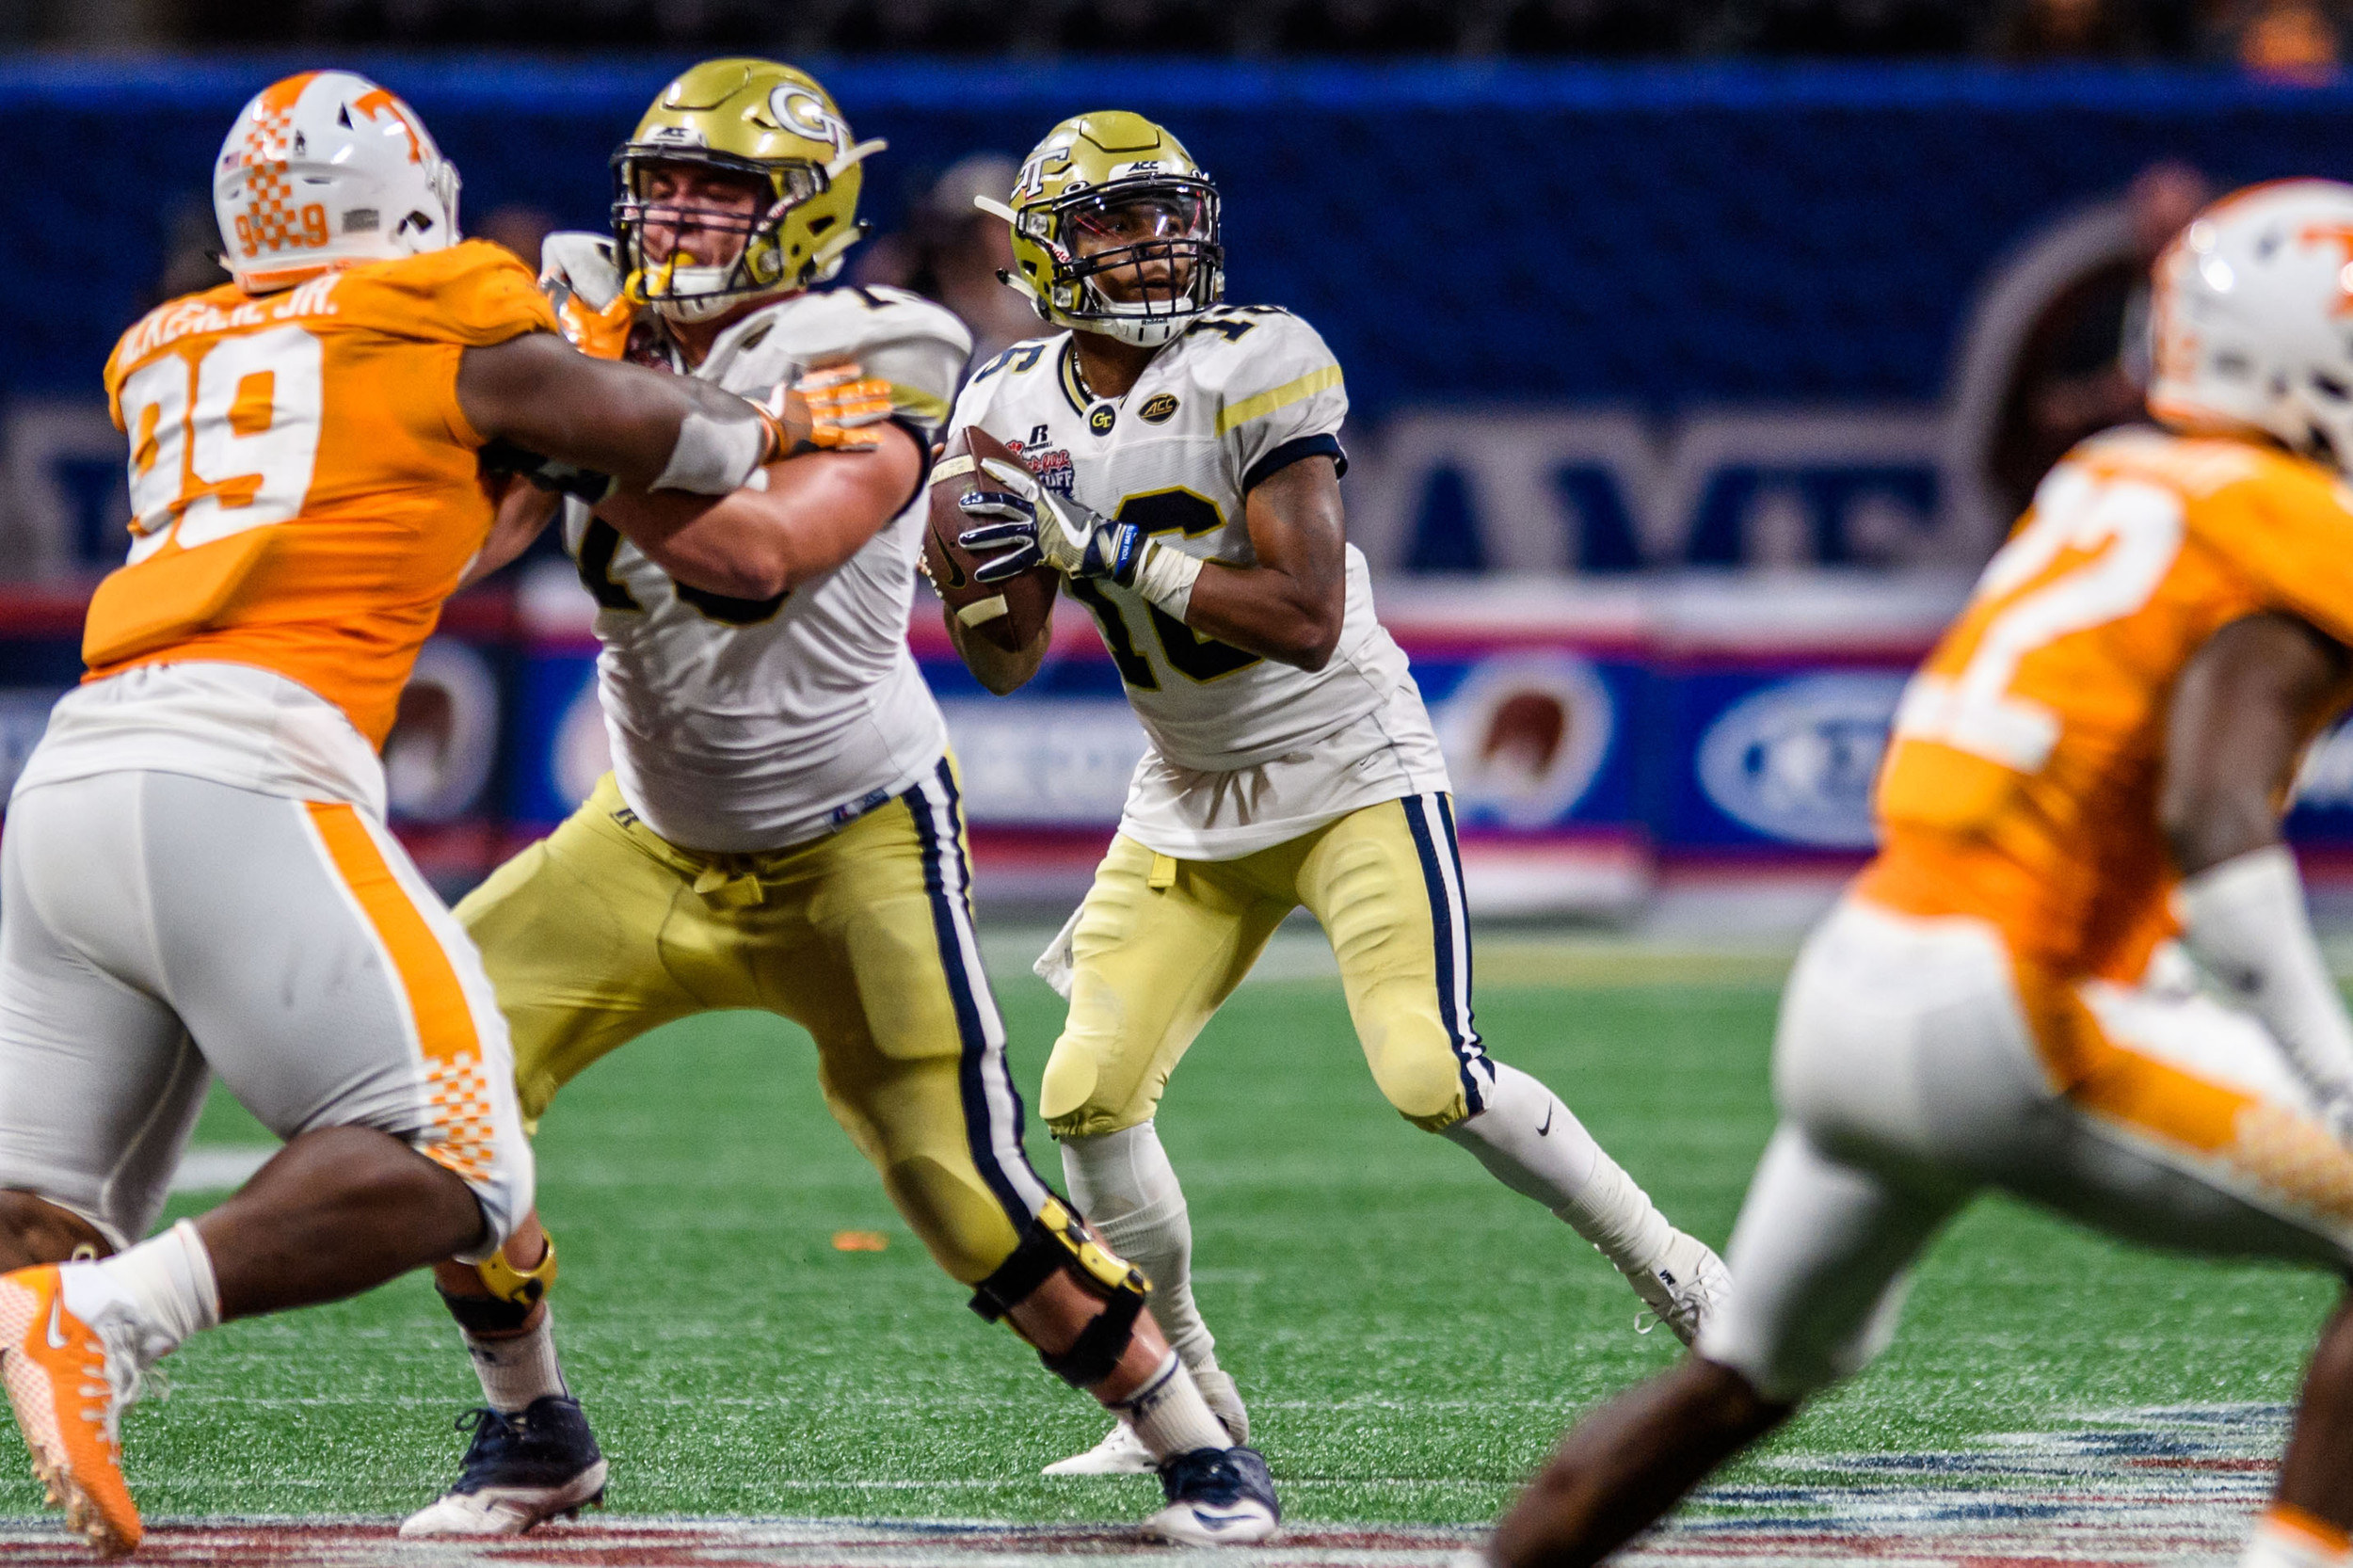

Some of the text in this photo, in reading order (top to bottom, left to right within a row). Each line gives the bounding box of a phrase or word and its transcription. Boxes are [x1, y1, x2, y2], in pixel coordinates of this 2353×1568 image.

[1128, 161, 1159, 172] ACC
[1142, 397, 1174, 416] ACC
[1092, 412, 1112, 428] GT
[119, 324, 323, 568] 99
